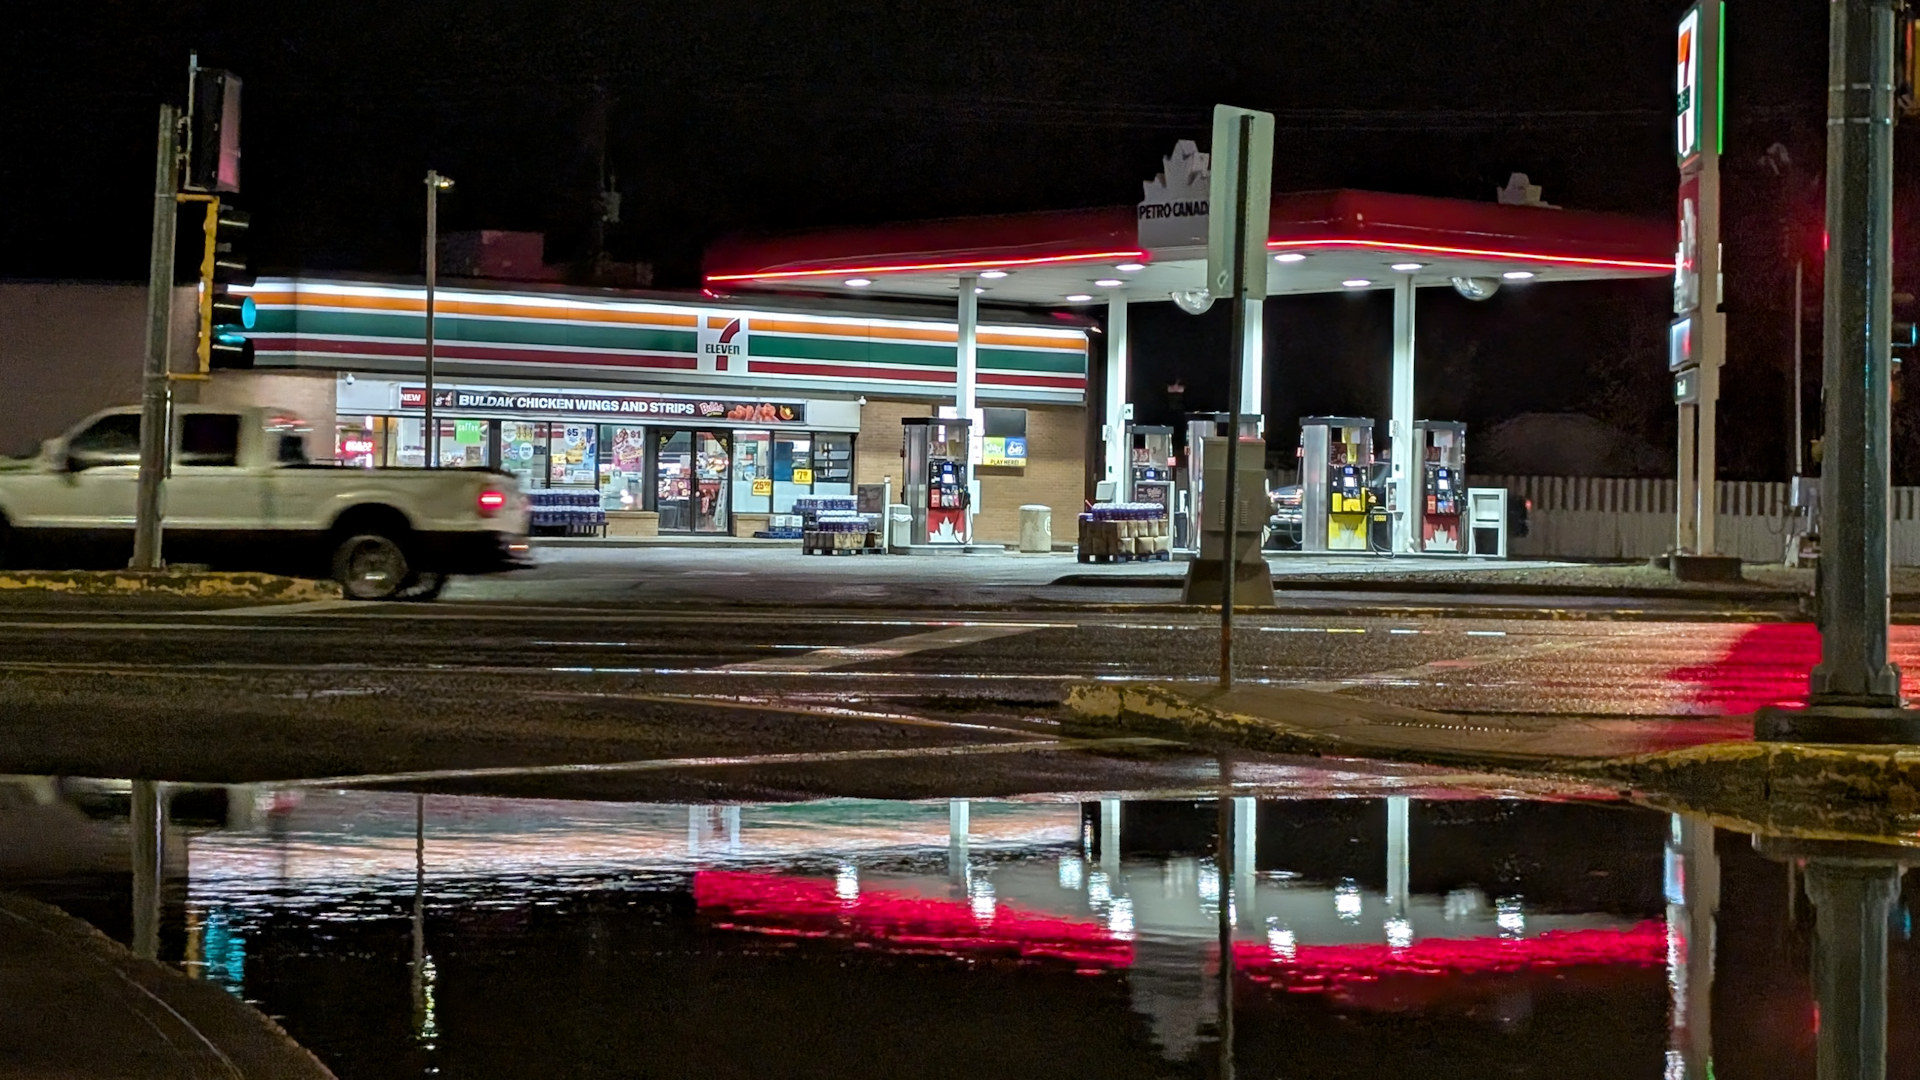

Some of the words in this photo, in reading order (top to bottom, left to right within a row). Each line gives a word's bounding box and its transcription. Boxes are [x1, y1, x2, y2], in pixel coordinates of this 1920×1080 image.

[707, 317, 740, 371] 7
[401, 393, 421, 402] NEW
[458, 394, 514, 408] BULDAK
[517, 397, 574, 410] CHICKEN
[575, 399, 620, 412] WINGS
[621, 401, 648, 413] AND
[649, 402, 695, 415] STRIPS
[567, 428, 579, 437] $5
